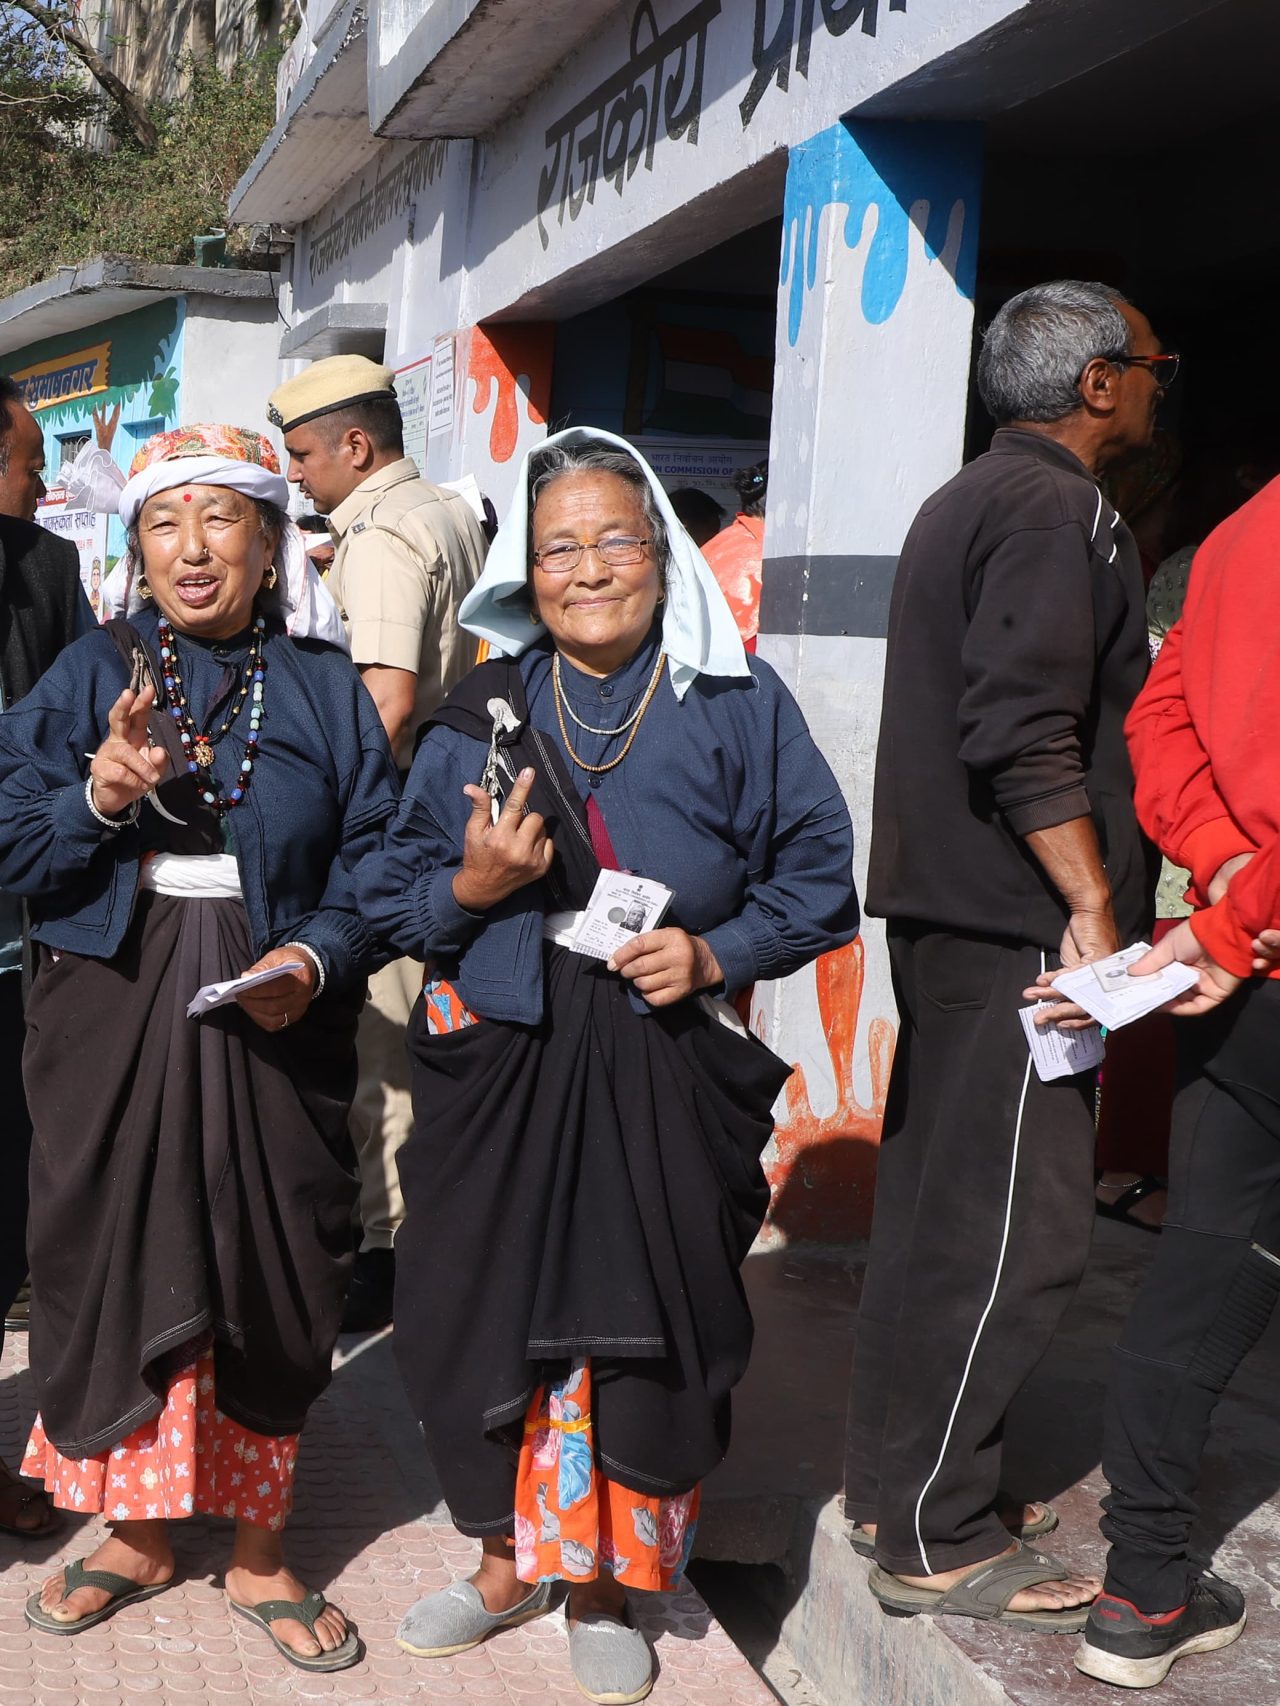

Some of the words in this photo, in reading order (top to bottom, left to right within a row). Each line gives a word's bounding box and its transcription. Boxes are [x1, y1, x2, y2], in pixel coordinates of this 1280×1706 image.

[536, 0, 725, 251] राजकीय
[309, 207, 344, 288] राजकीय
[651, 453, 671, 463] भारत
[664, 465, 720, 475] COMMISION
[721, 467, 735, 476] OF
